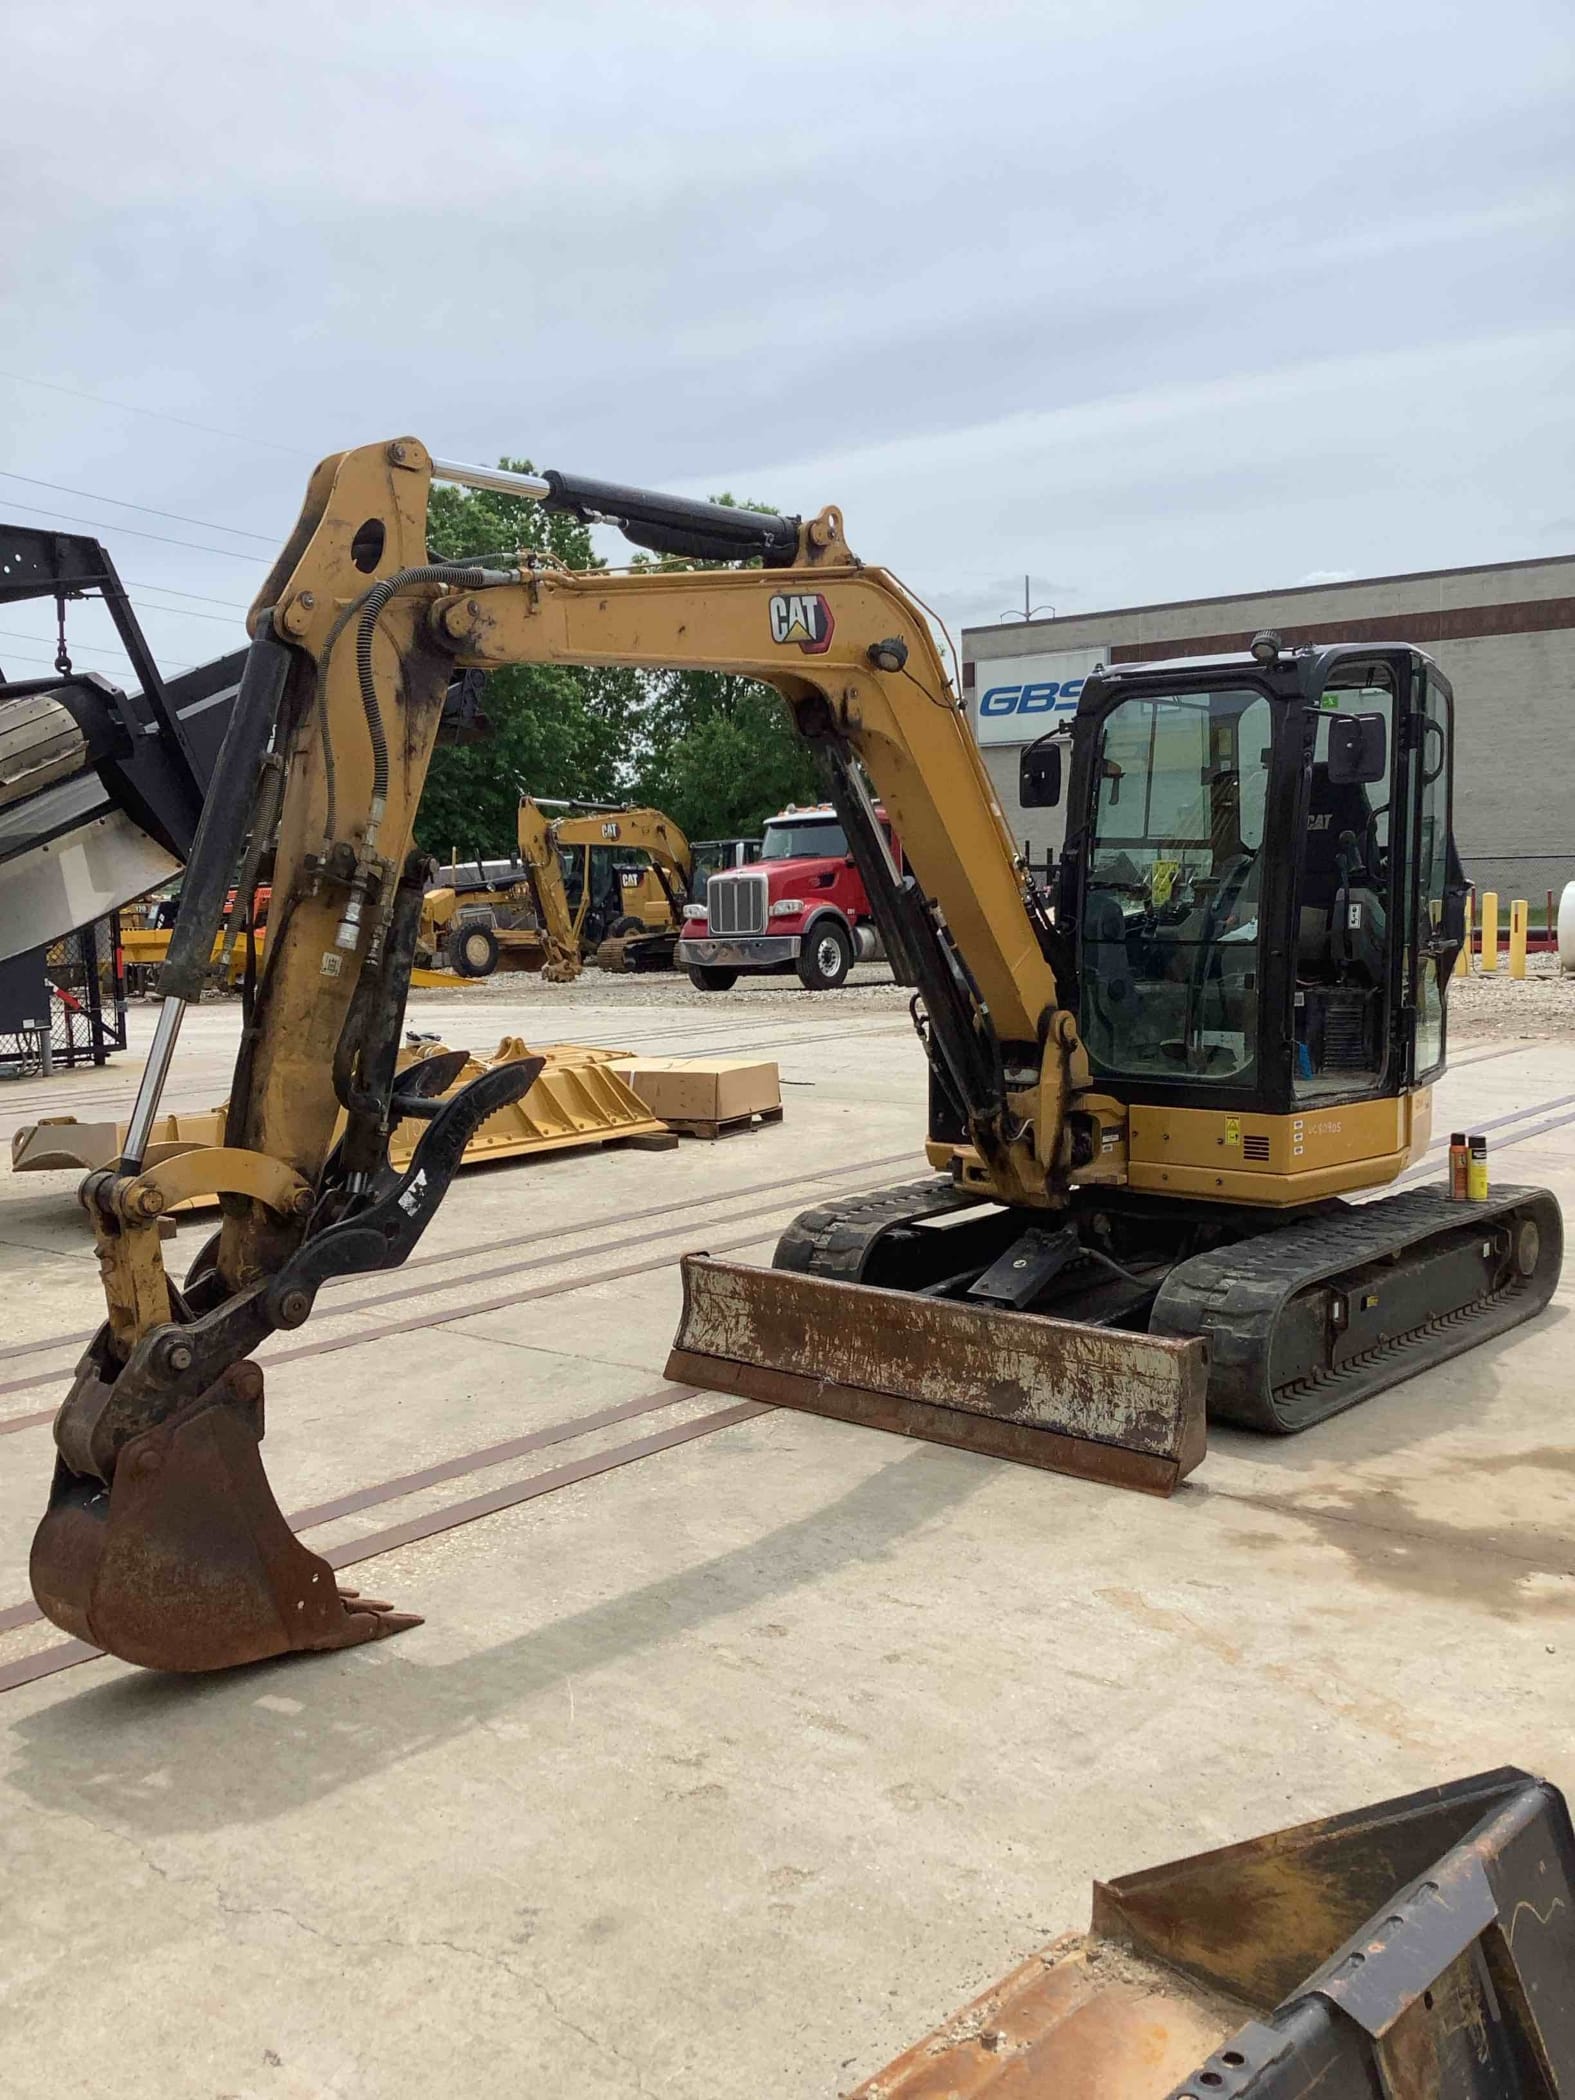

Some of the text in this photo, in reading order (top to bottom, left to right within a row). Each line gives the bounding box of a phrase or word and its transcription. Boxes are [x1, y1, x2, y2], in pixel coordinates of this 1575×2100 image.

[770, 595, 818, 642] CAT
[601, 823, 617, 838] CAT
[622, 873, 638, 887] CAT
